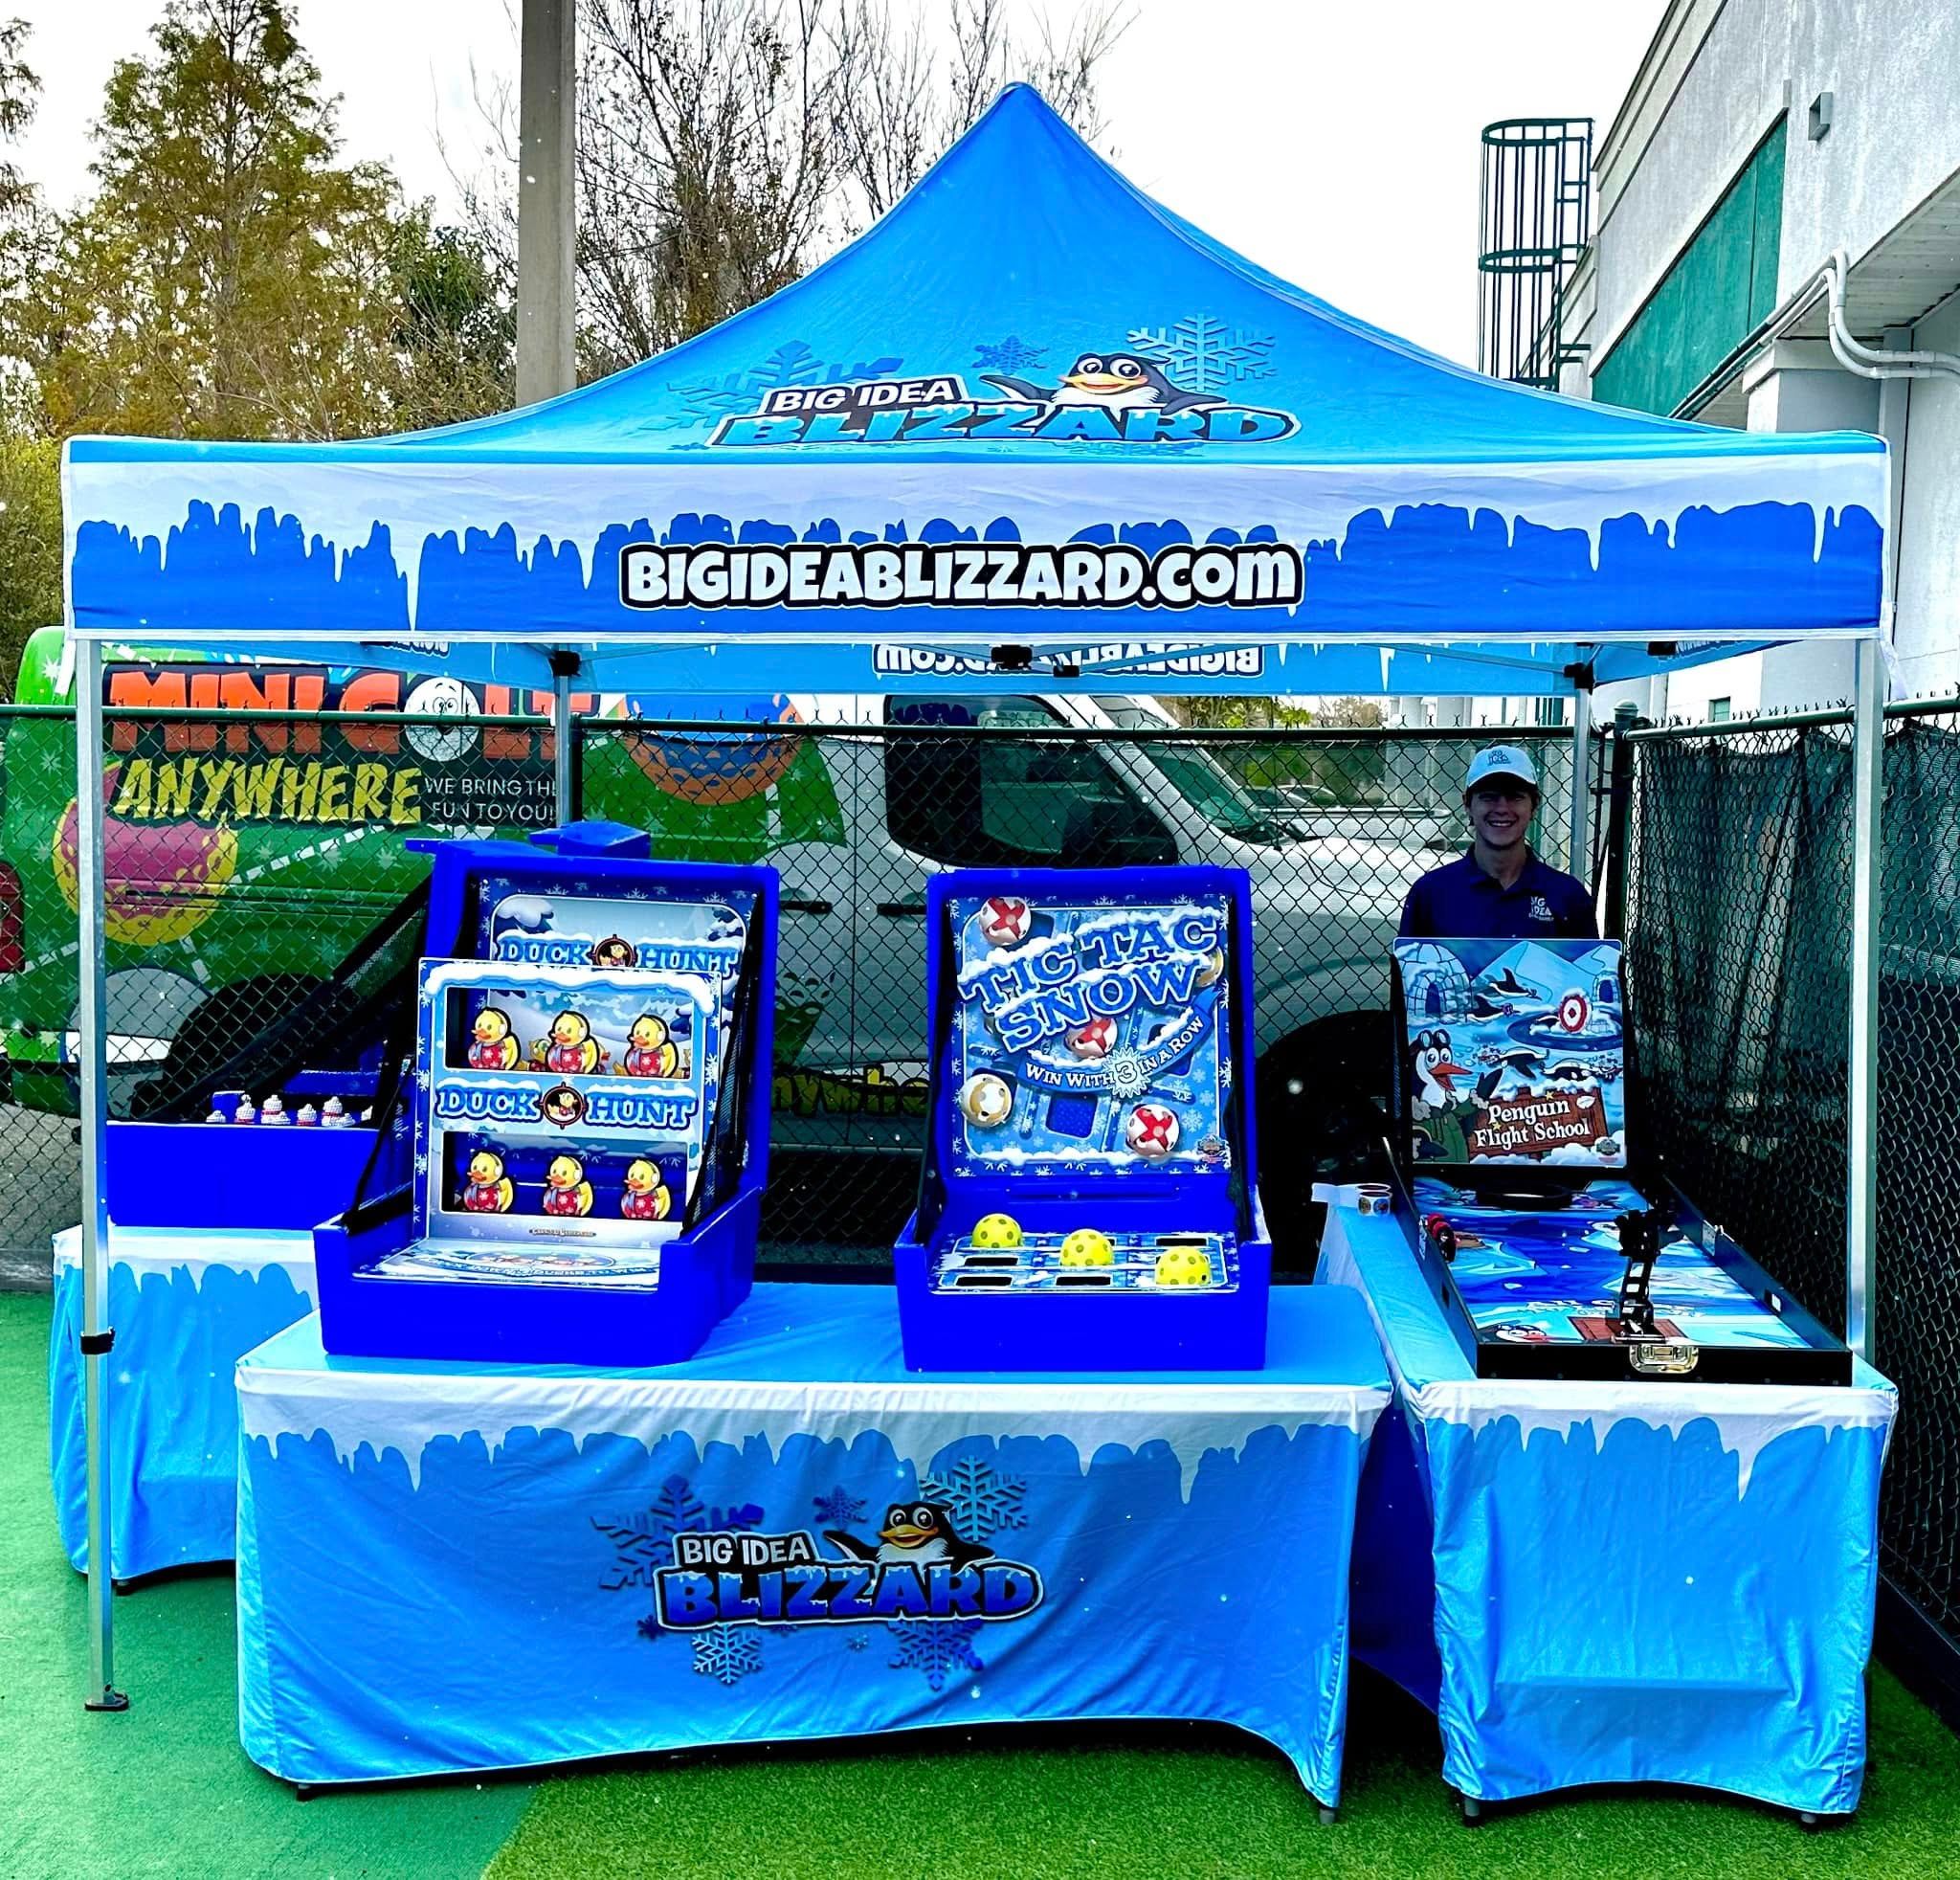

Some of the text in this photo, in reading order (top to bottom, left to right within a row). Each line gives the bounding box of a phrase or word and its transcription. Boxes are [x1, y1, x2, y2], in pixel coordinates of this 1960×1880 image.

[770, 382, 956, 413] BIG IDEA
[720, 402, 1288, 444] BLIZZARD
[627, 548, 1299, 603] BIGIDEABLIZZARD.com
[109, 671, 324, 754] MINI
[112, 757, 423, 826] ANYWHERE
[424, 777, 455, 795] WE
[461, 777, 523, 796] BRING
[433, 801, 470, 819] FUN
[476, 802, 502, 820] TO
[497, 935, 738, 976] DUCK HUNT
[957, 914, 1217, 1014] TIC TAC
[994, 958, 1204, 1052] SNOW
[1025, 1015, 1206, 1088] WIN WITH 3 IN A ROW
[437, 1085, 698, 1127] DUCK HUNT
[1487, 1100, 1570, 1126] Penguin
[1474, 1118, 1591, 1152] Flight School
[681, 1535, 813, 1566] BIG IDEA
[662, 1568, 1035, 1623] BLIZZARD
